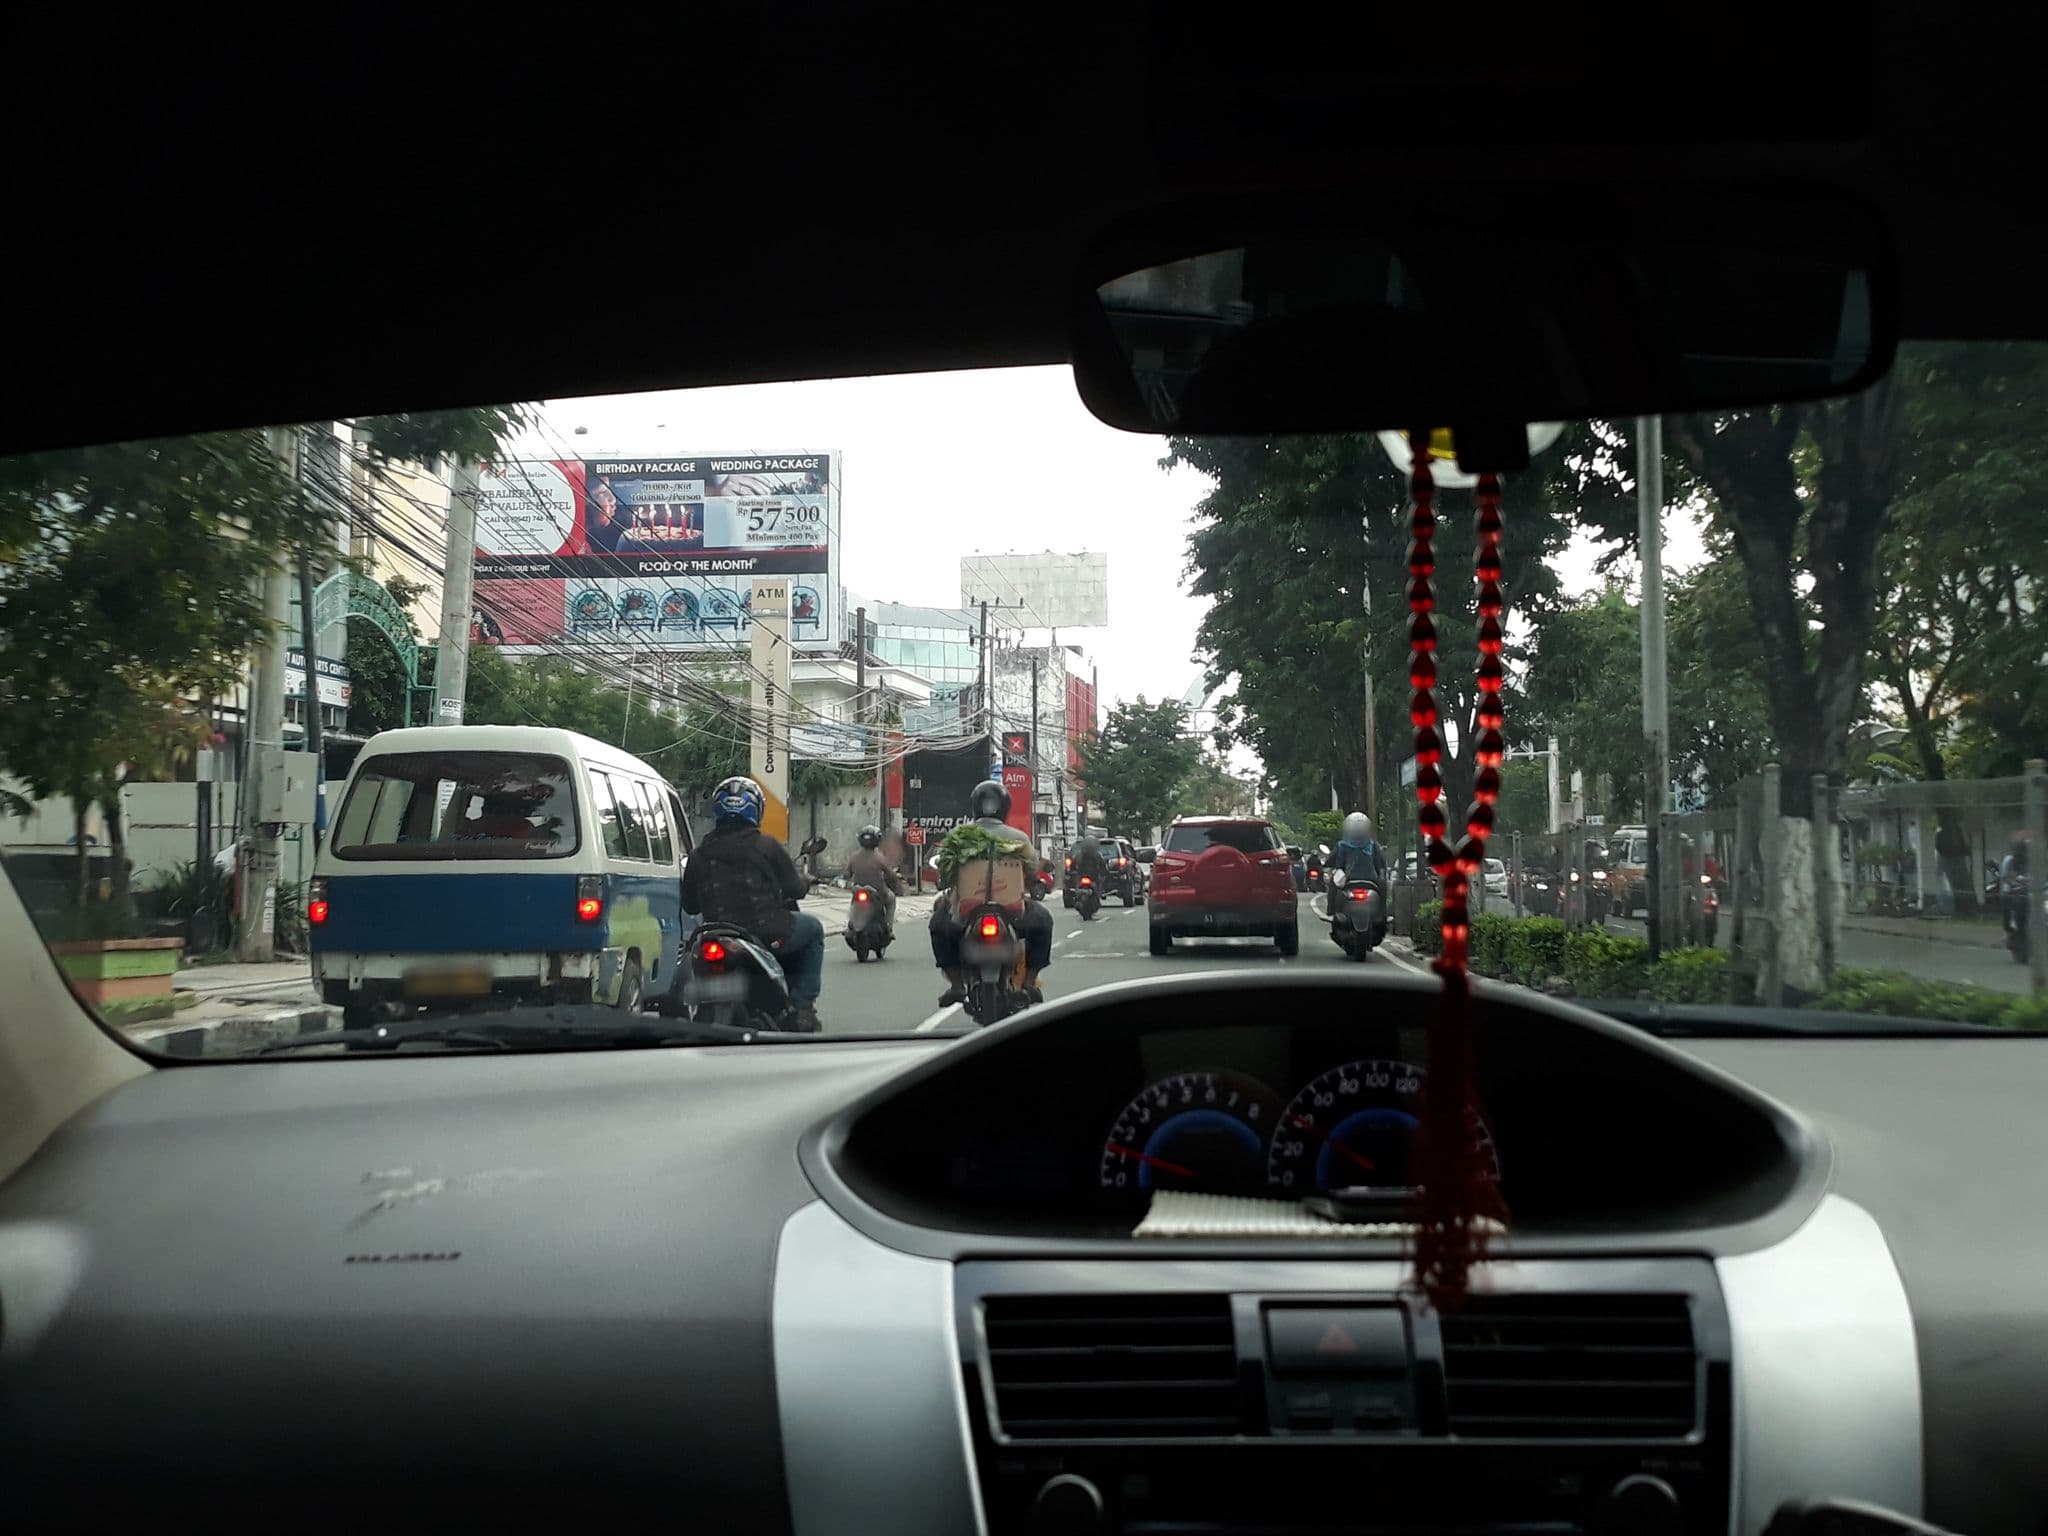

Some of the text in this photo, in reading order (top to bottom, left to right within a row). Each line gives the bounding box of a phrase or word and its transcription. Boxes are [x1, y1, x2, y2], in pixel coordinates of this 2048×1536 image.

[596, 462, 696, 474] BIRTHDAY PACKAGE
[710, 458, 819, 471] WEDDING PACKAGE
[499, 501, 533, 511] VALUE
[536, 501, 571, 511] HOTEL
[746, 532, 787, 541] Minimum
[639, 559, 753, 571] FOOD OF THE MONTH
[756, 588, 785, 598] ATM
[1338, 1078, 1359, 1095] 80
[1365, 1072, 1390, 1088] 100
[1395, 1077, 1420, 1094] 120
[1204, 1086, 1216, 1102] 6
[1314, 1091, 1335, 1108] 60
[1248, 1103, 1260, 1119] 8
[1125, 1126, 1136, 1141] 2
[1283, 1141, 1303, 1157] 20
[1115, 1172, 1126, 1187] 0
[1281, 1171, 1294, 1187] 0
